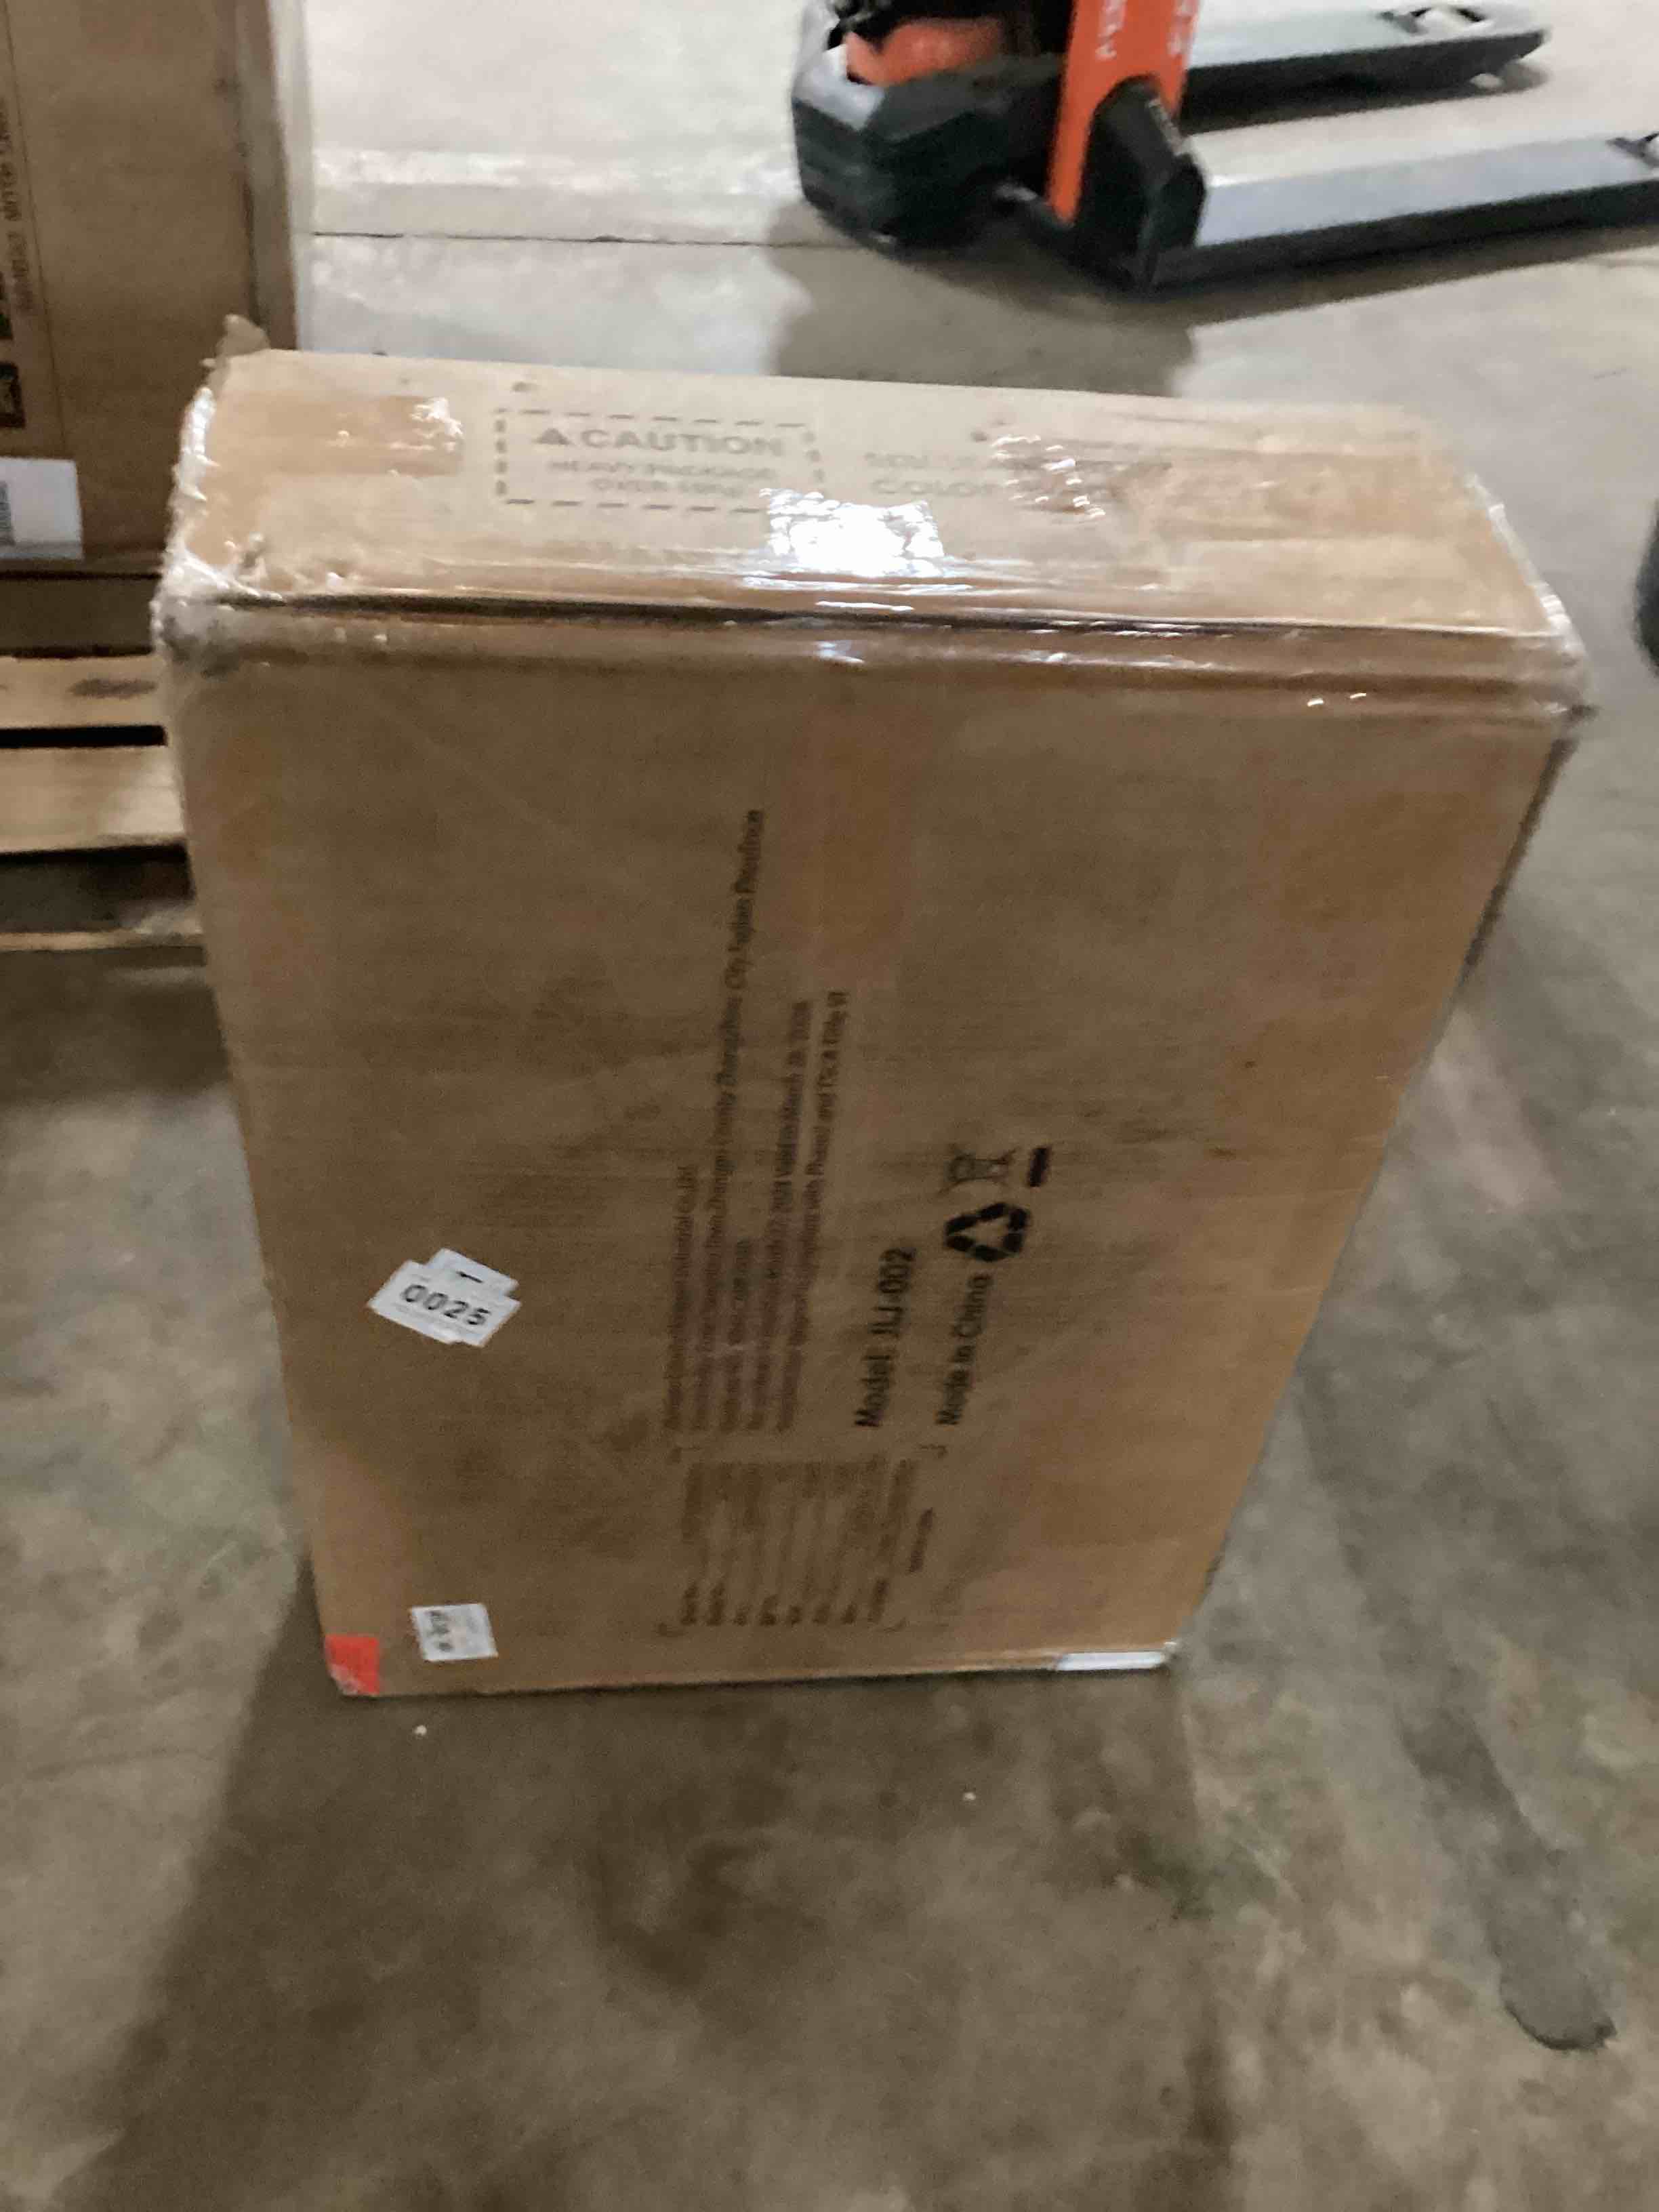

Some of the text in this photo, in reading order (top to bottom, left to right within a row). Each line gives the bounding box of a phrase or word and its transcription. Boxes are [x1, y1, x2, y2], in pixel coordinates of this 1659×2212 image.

[580, 428, 786, 457] CAUTION
[400, 1284, 492, 1326] 0025
[950, 1272, 994, 1338] China
[934, 1369, 972, 1426] Made
